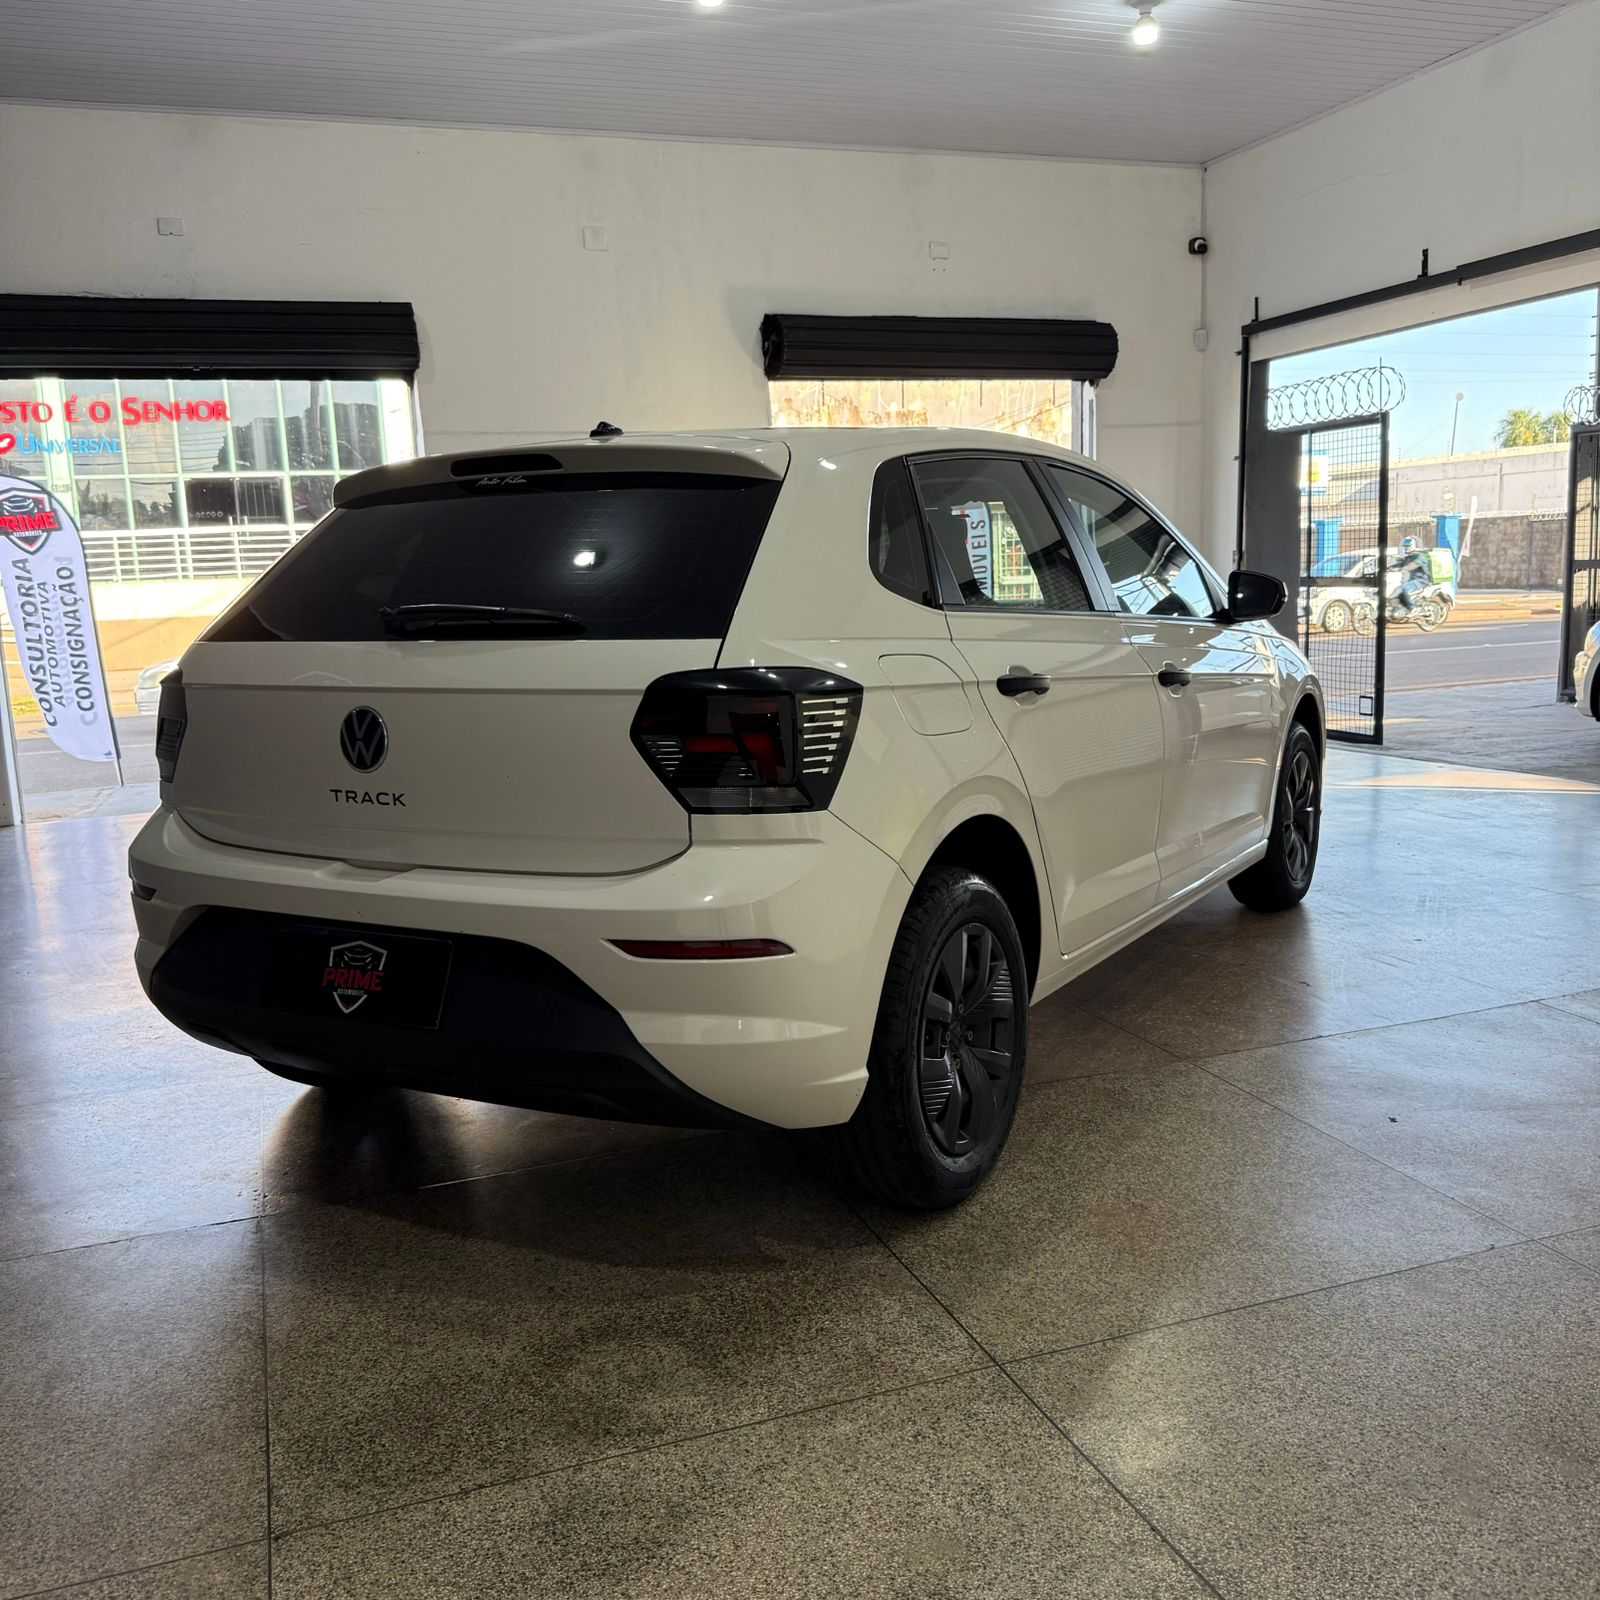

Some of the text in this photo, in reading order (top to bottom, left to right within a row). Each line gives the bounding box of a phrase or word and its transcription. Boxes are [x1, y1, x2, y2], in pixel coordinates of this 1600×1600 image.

[65, 394, 80, 423] É
[88, 401, 111, 424] O
[12, 558, 57, 727] CONSULTORIA
[37, 582, 66, 708] AUTOMOTIVA
[53, 566, 95, 712] CONSIGNAÇÃO
[329, 789, 406, 807] TRACK
[322, 967, 385, 991] PRIME
